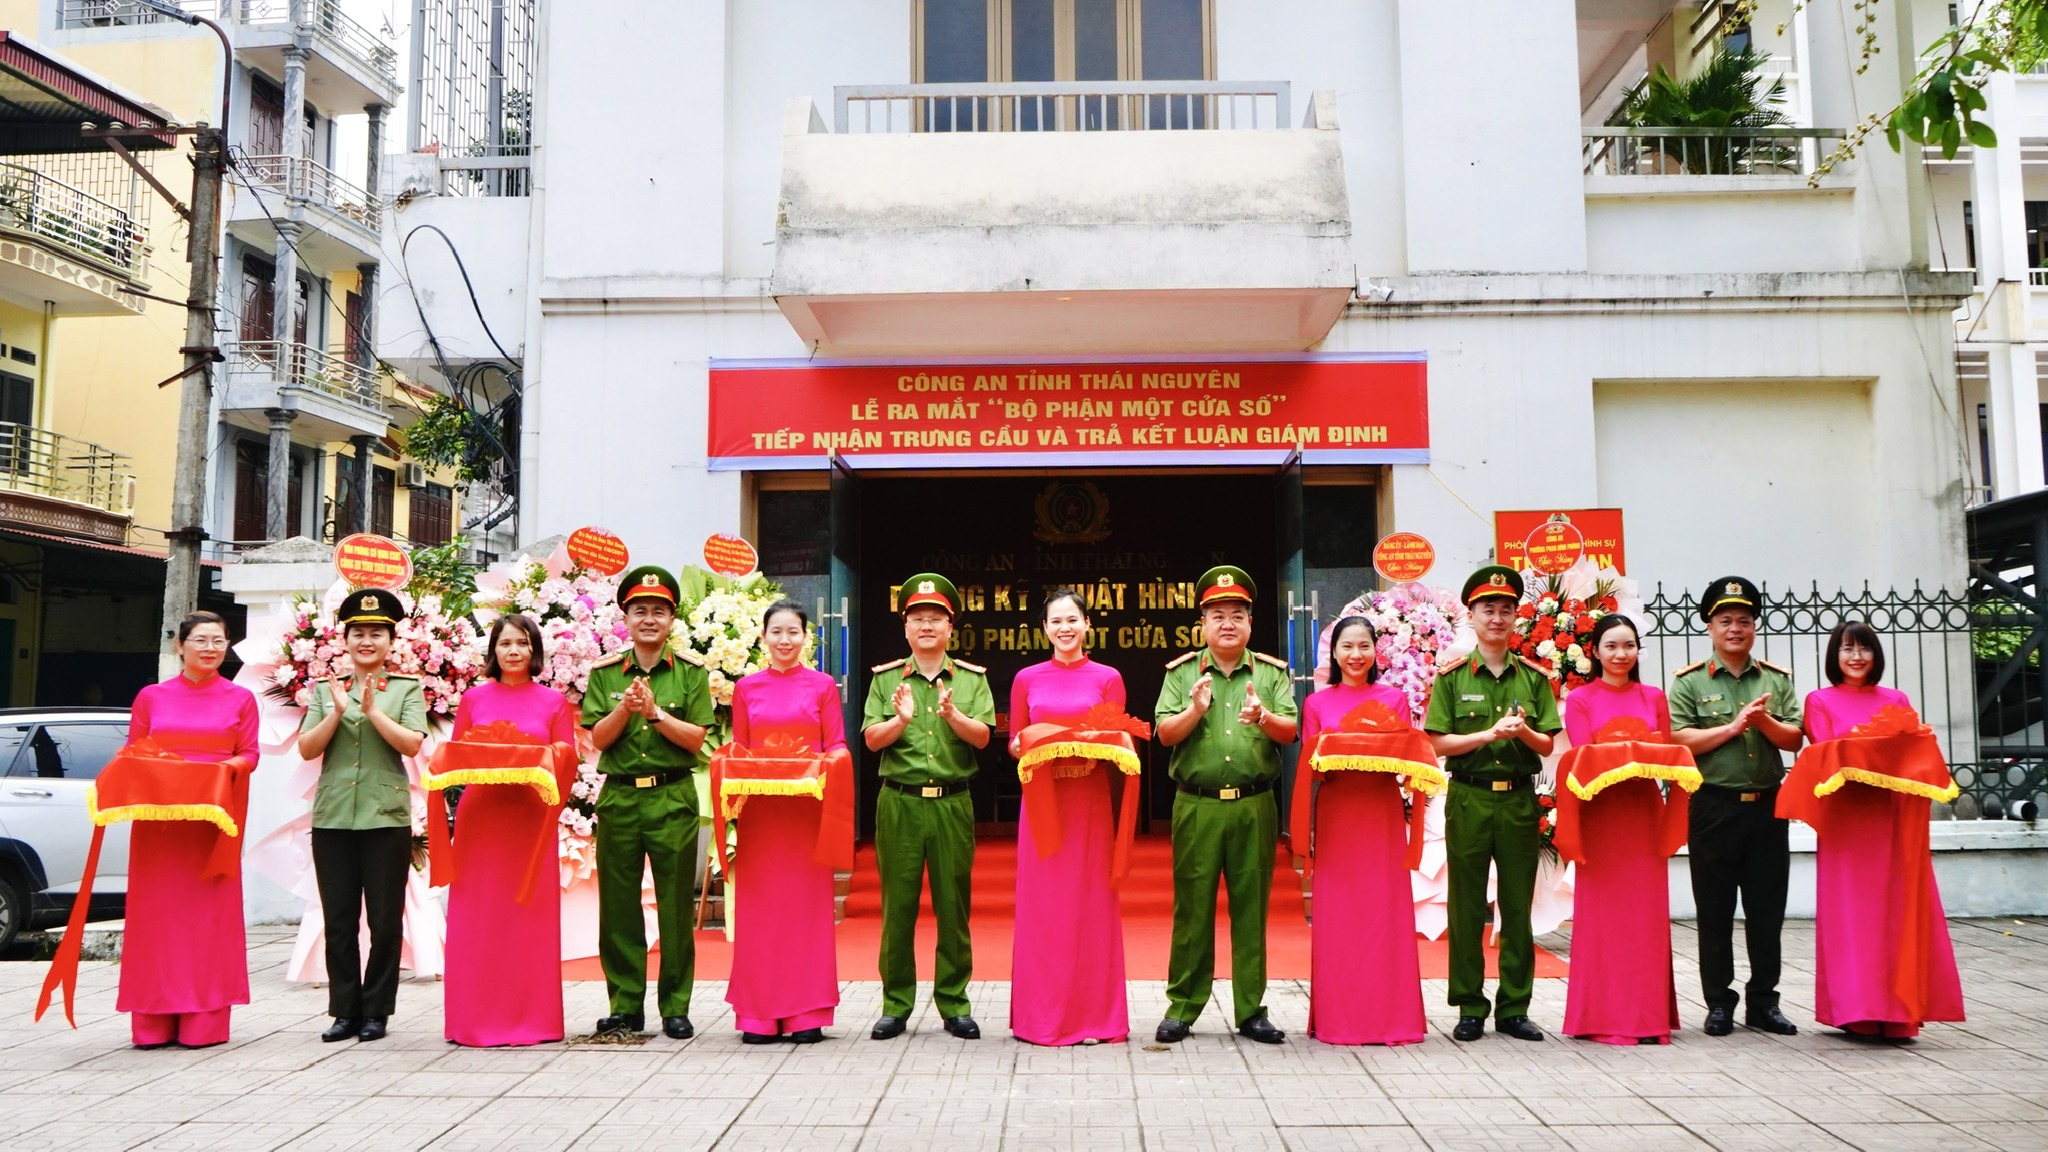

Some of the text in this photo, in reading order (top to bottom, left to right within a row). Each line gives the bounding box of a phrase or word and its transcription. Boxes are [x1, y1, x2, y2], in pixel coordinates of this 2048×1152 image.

[898, 369, 1240, 392] CÔNG AN TỈNH THÁI NGUYÊN
[852, 398, 879, 421] LỄ
[887, 402, 919, 420] RA
[927, 396, 980, 419] MẮT
[1045, 398, 1113, 421] PHẬN
[1121, 397, 1173, 420] MỘT
[1181, 394, 1231, 416] CỬA
[752, 423, 1387, 451] TIẾP NHẬN TRƯNG CẦU VÀ TRẢ KẾT LUẬN GIÁM ĐỊNH
[984, 552, 1016, 571] AN
[983, 623, 1050, 657] PHẬN
[1118, 617, 1168, 649] CỬA
